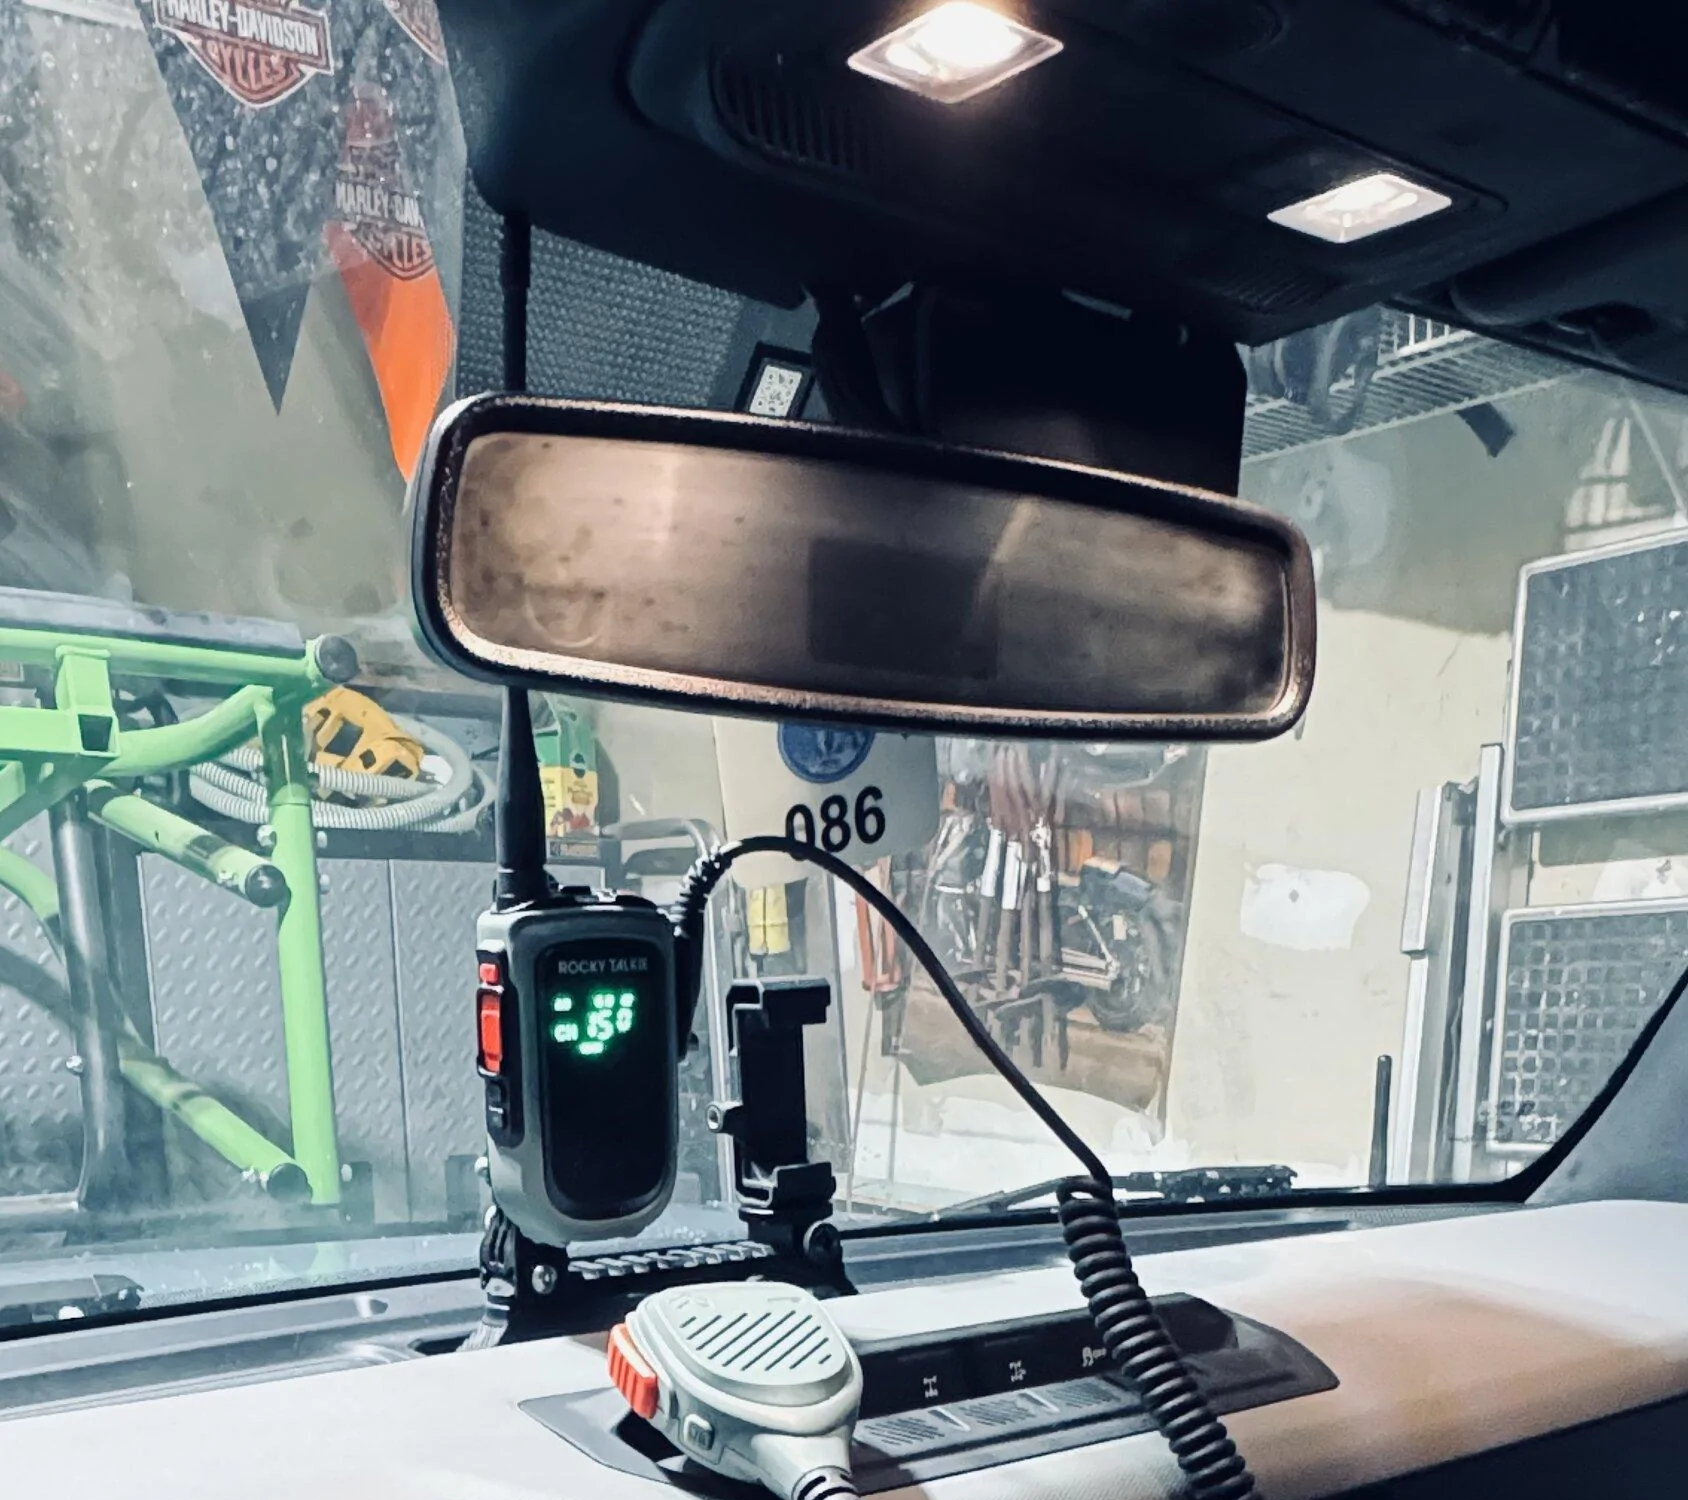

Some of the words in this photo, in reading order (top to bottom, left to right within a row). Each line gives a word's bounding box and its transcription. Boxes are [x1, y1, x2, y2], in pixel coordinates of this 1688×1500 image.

[785, 785, 886, 862] 086
[558, 958, 606, 975] ROCKY
[608, 955, 649, 973] TALKIE
